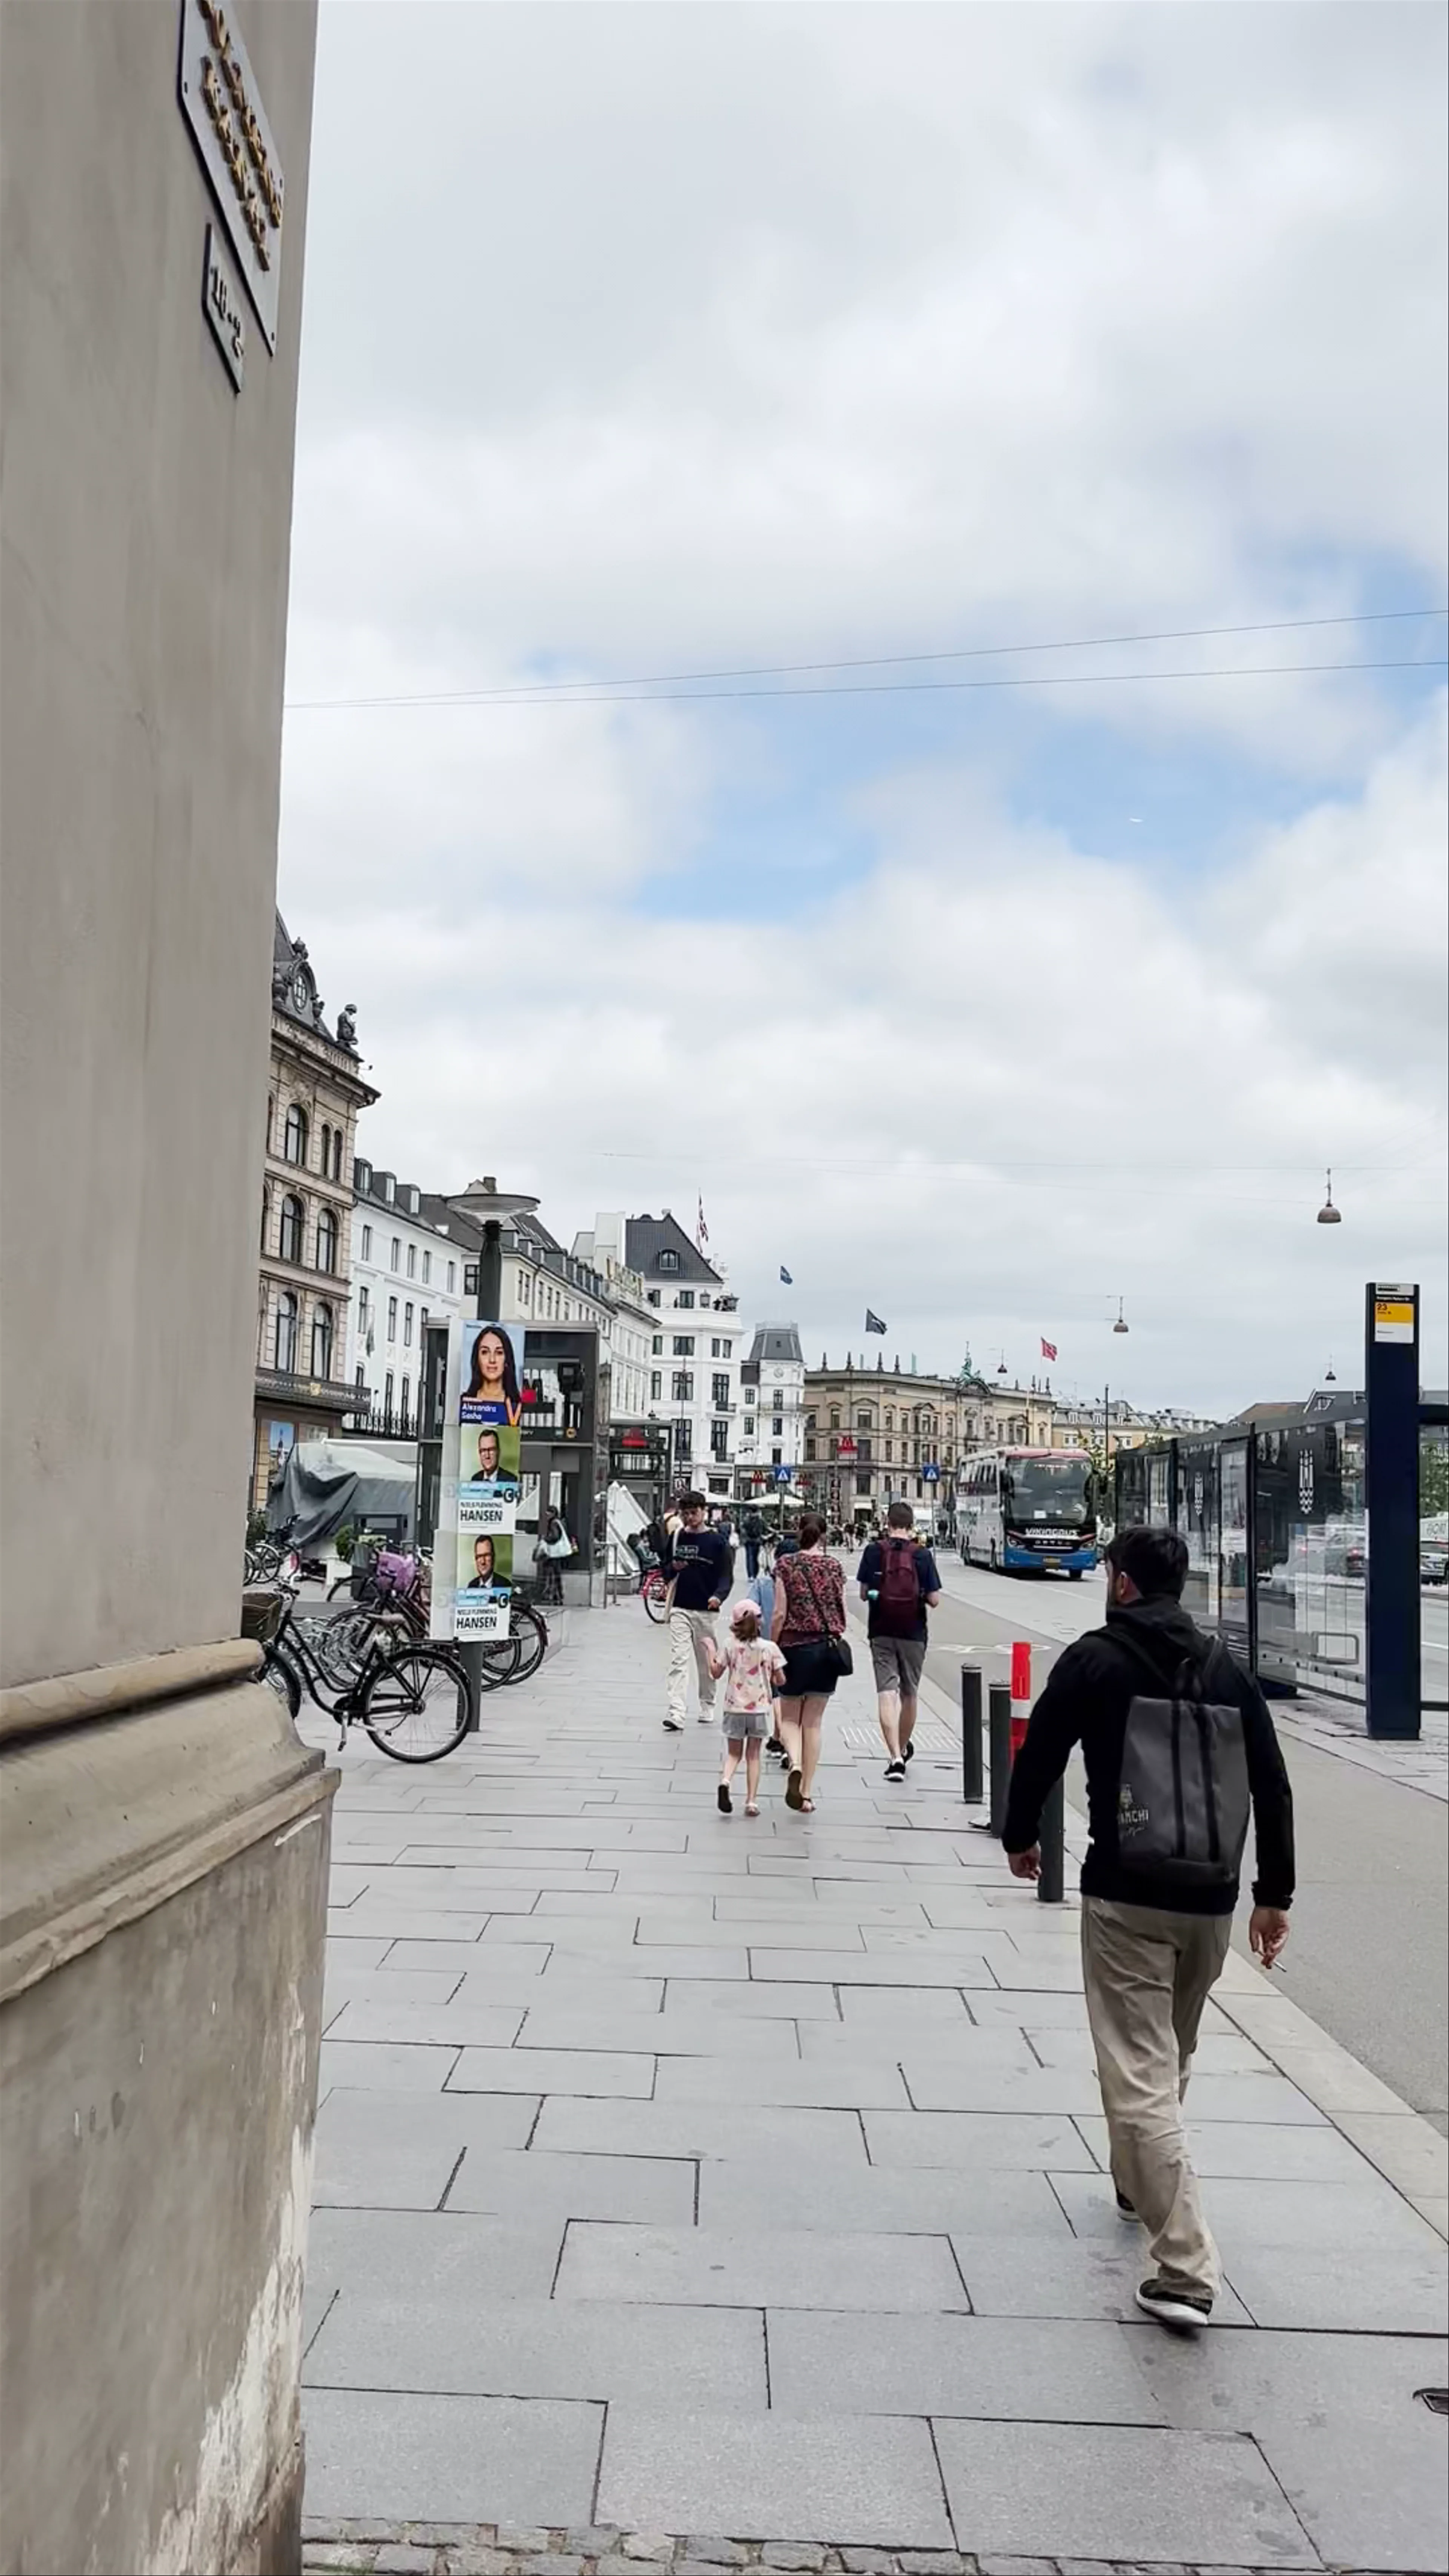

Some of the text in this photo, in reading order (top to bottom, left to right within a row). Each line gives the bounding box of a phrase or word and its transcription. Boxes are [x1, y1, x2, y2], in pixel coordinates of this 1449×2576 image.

[462, 1403, 497, 1412] Alexandra
[460, 1510, 503, 1521] HANSEN
[456, 1616, 497, 1629] HANSEN
